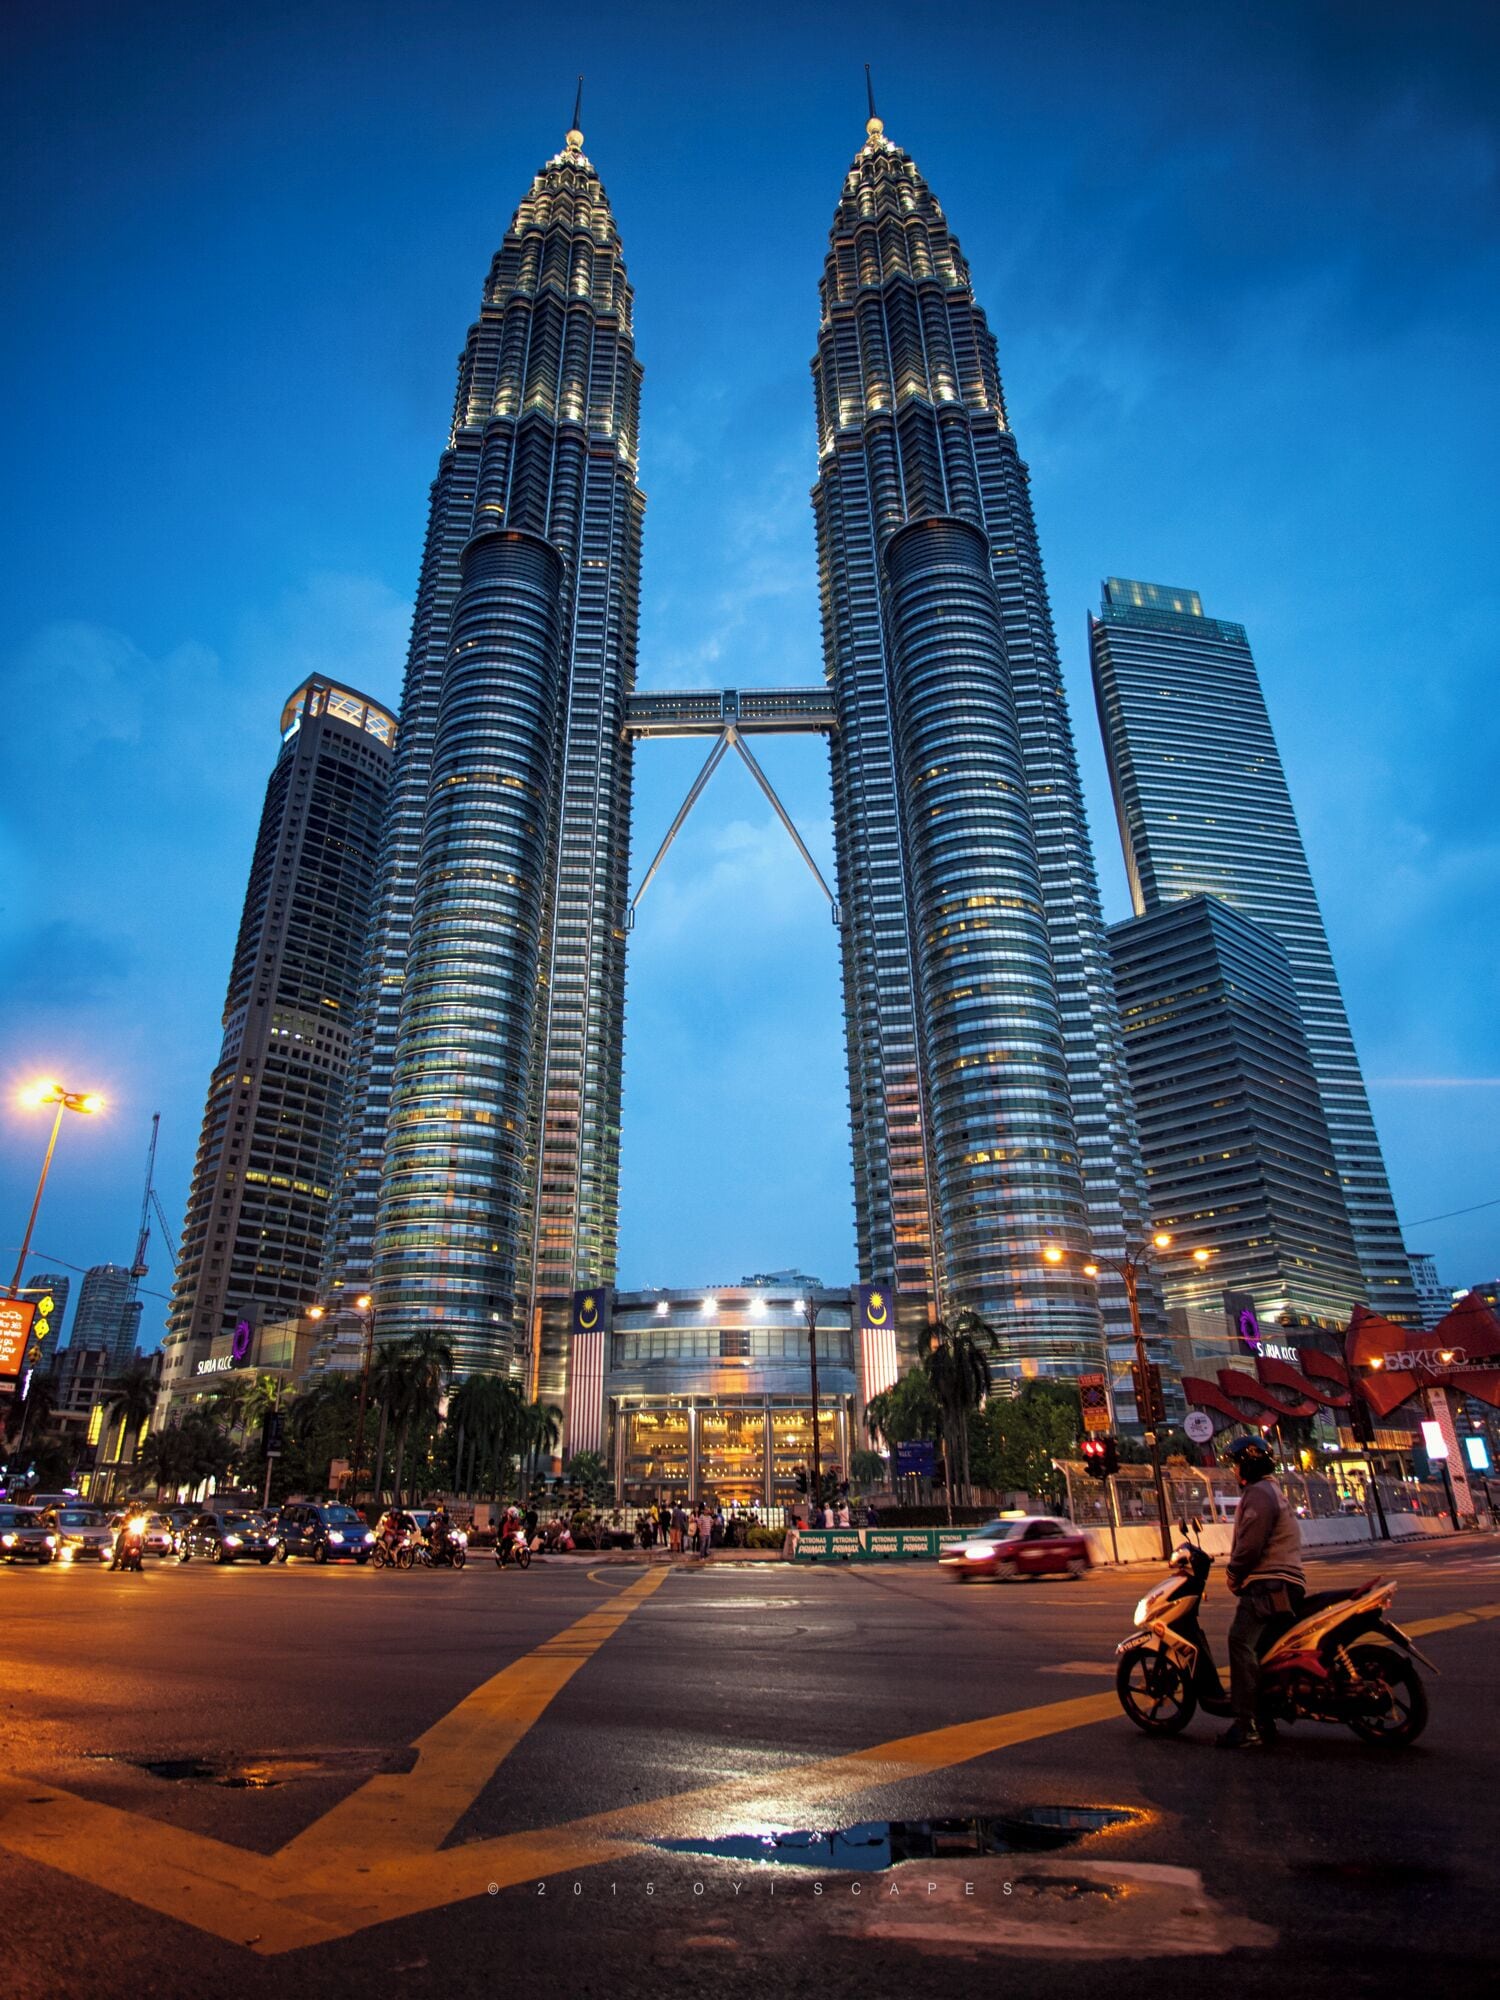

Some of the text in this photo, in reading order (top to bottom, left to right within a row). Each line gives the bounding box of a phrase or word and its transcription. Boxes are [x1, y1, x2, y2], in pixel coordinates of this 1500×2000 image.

[1256, 1341, 1282, 1360] SRIA
[196, 1358, 217, 1375] SURIA
[798, 1536, 827, 1544] PETRONAS
[871, 1535, 898, 1543] PETRONAS
[797, 1544, 827, 1554] PRIMAX
[831, 1544, 859, 1553] PRIMAX
[871, 1543, 898, 1552] PRIMAX
[902, 1543, 928, 1551] PRIMAX
